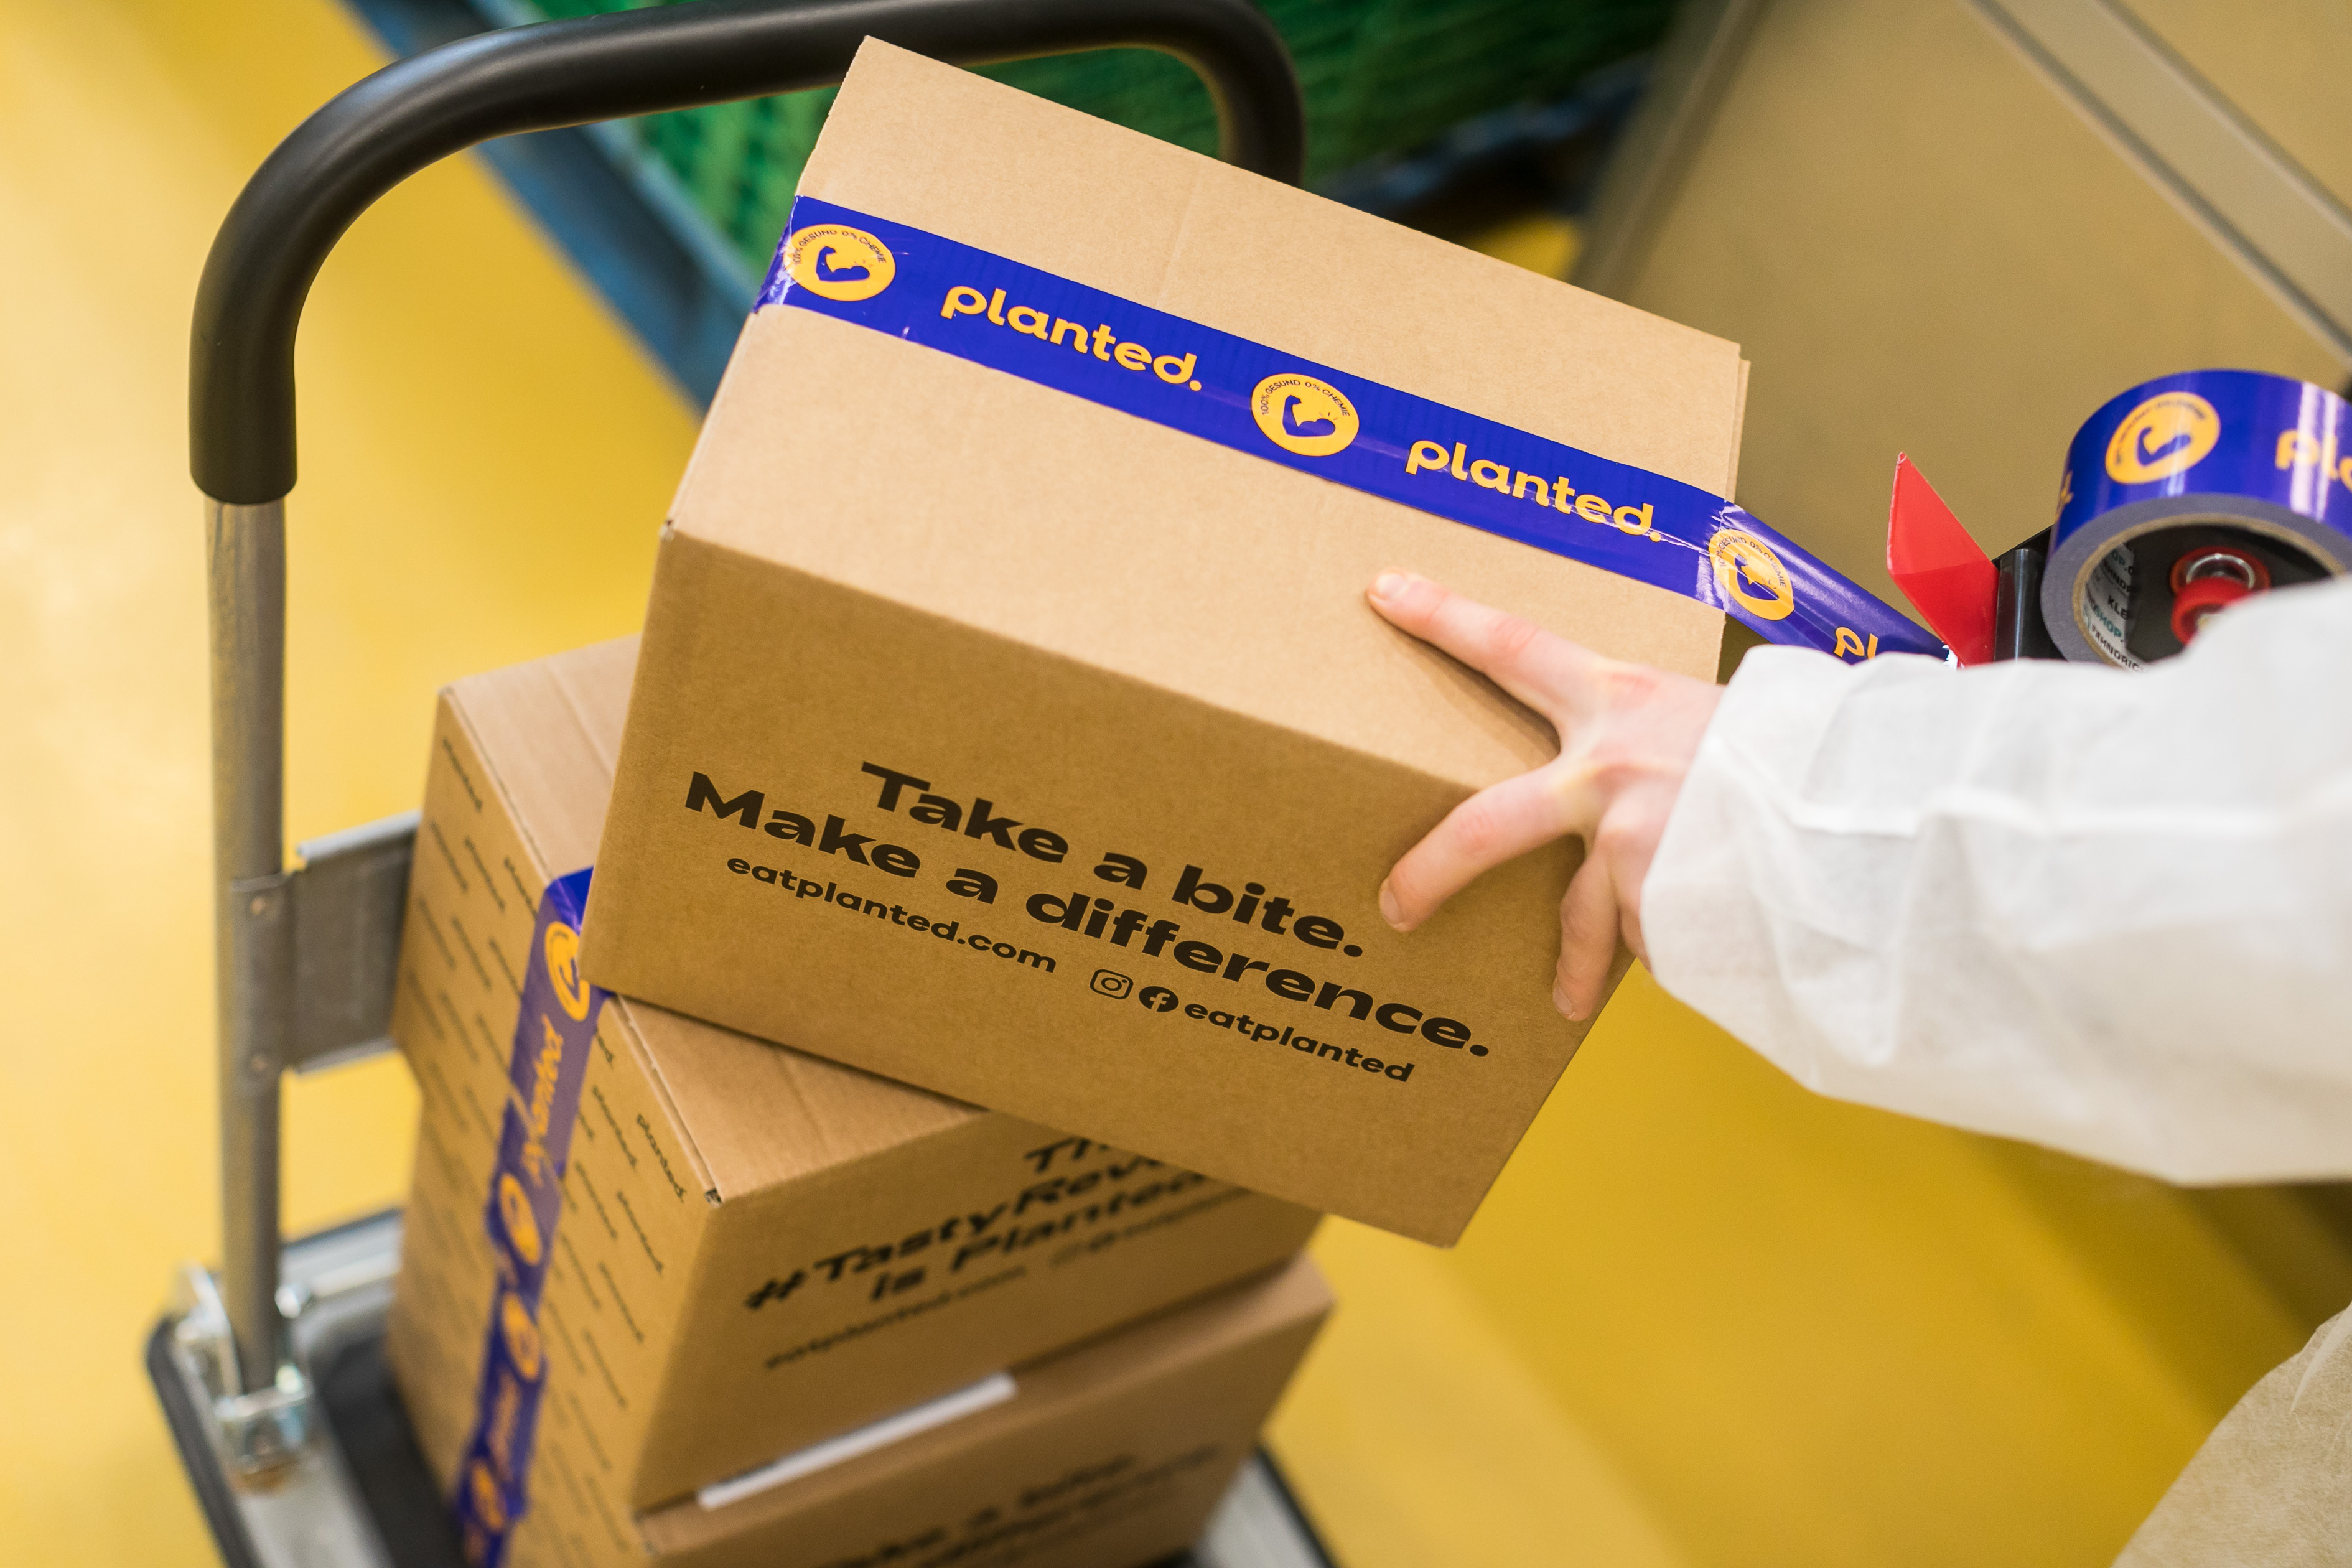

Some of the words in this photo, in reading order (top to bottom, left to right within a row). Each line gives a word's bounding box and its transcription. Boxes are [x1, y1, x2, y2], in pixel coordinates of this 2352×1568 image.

[799, 230, 837, 247] GESUND
[842, 231, 857, 239] 0%
[859, 236, 887, 263] CHEMIE
[940, 286, 1202, 392] planted.
[1260, 394, 1270, 416] 100%
[1265, 380, 1300, 395] GESUND
[1305, 381, 1320, 391] 0%
[1322, 389, 1350, 417] CHEMIE
[1405, 440, 1662, 543] planted.
[1719, 536, 1747, 550] GESUND
[1764, 553, 1786, 588] CHEMIE
[861, 761, 1068, 864] Take
[1093, 852, 1147, 890] a
[1171, 864, 1363, 958] bite.
[684, 771, 921, 879] Make
[946, 867, 999, 905] a
[1025, 892, 1489, 1057] difference.
[727, 857, 1057, 973] eatplanted.com
[1184, 1003, 1416, 1083] eatplanted
